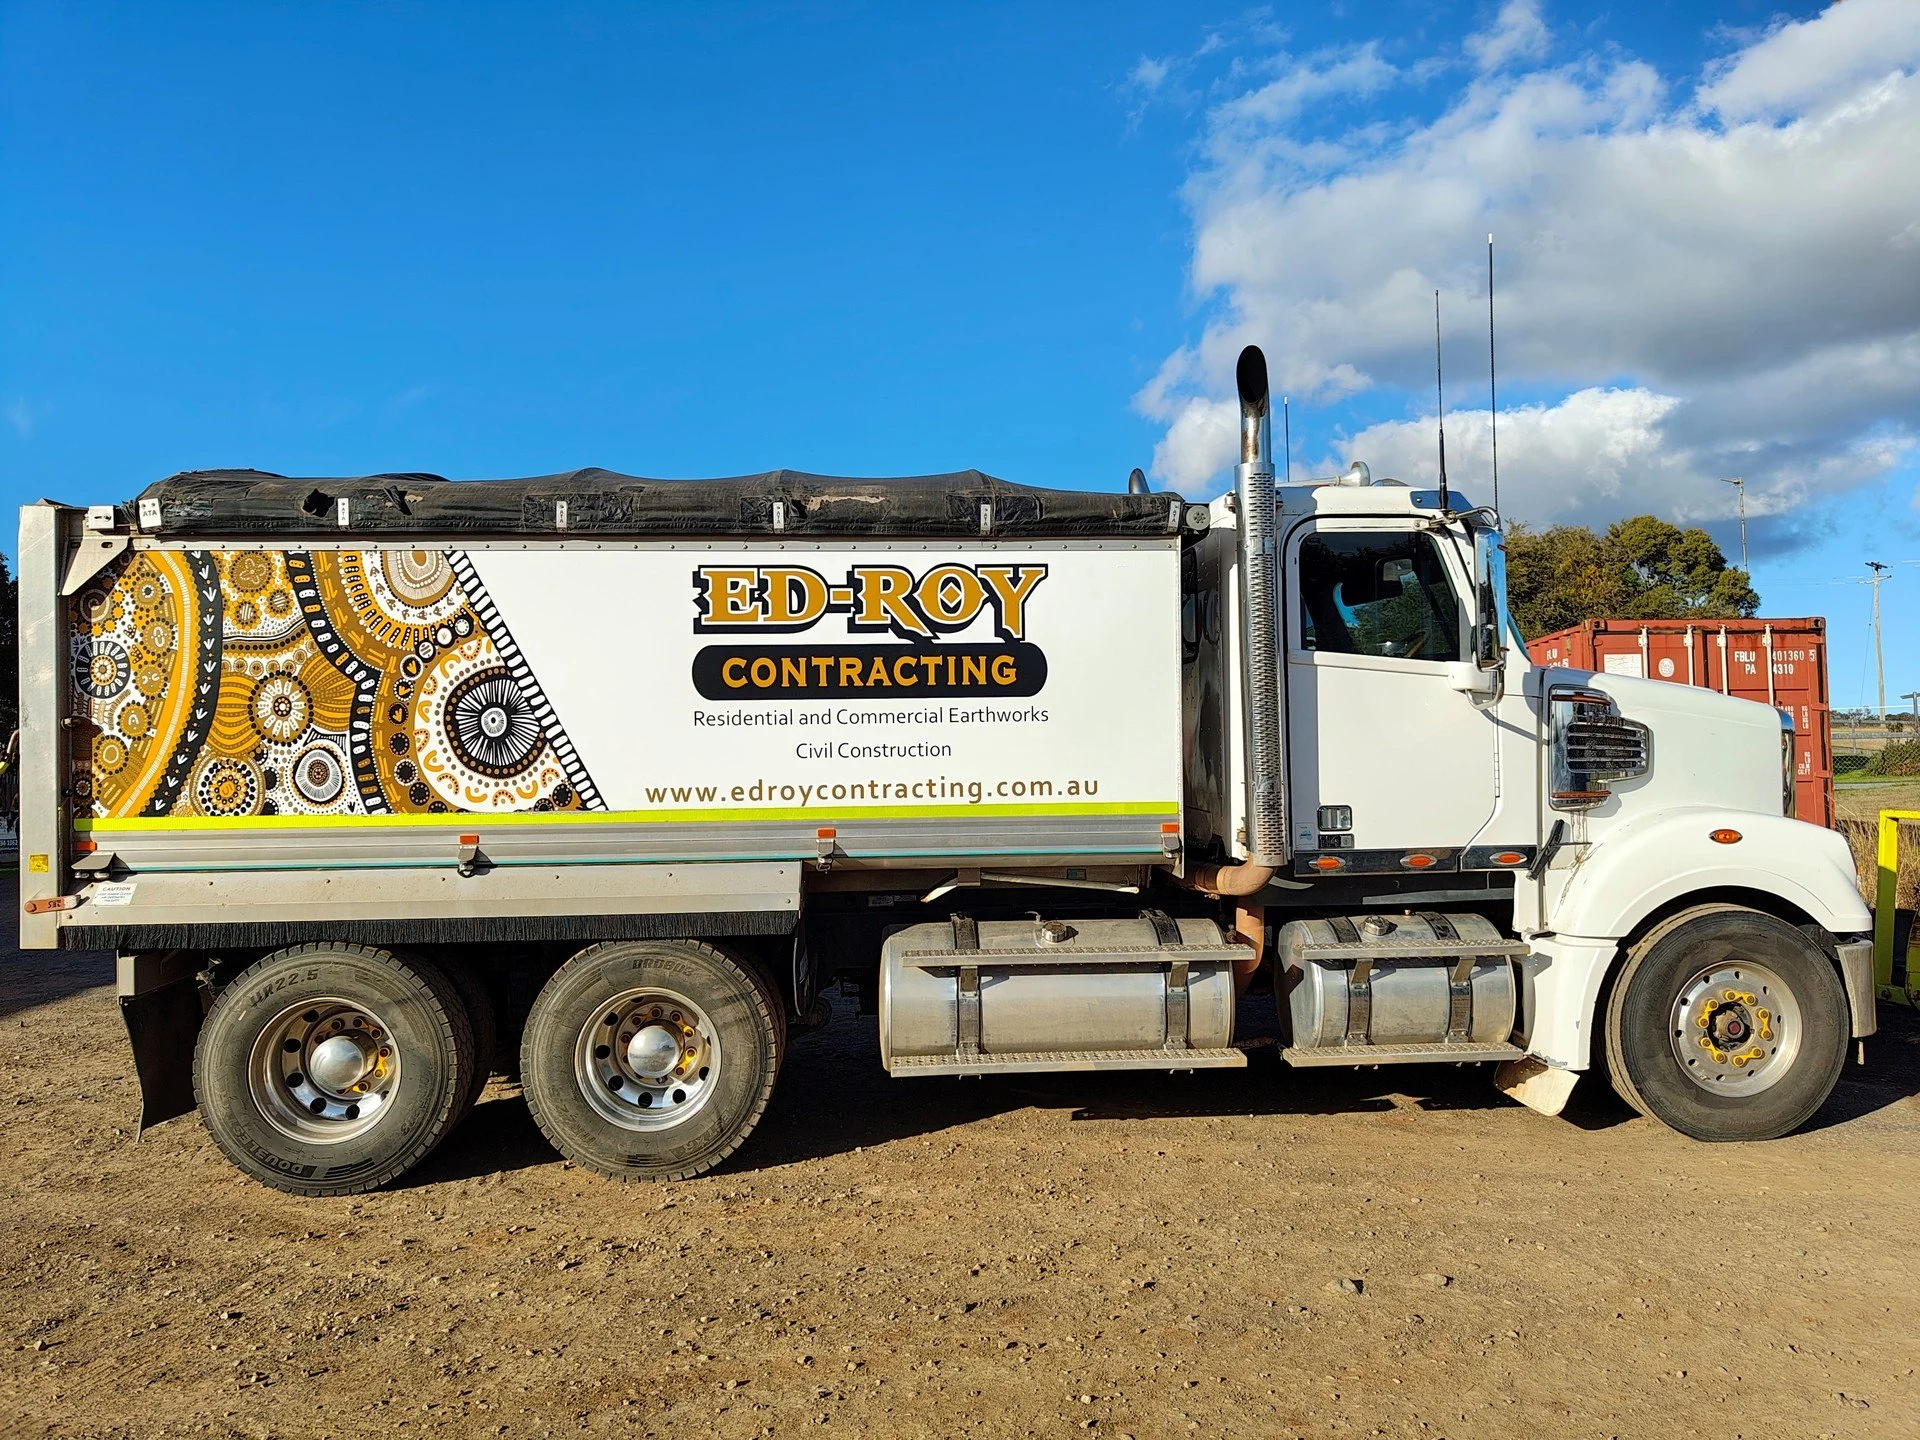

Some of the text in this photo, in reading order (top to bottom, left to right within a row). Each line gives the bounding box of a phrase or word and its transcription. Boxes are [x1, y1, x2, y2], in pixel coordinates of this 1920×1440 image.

[695, 564, 1048, 641] ED-ROY
[1734, 650, 1756, 662] FBLU
[721, 654, 1017, 688] CONTRACTING
[1745, 664, 1794, 675] PA 4310
[693, 706, 1049, 726] Residential and Commercial Earthworks
[796, 742, 951, 758] Civil Construction
[645, 776, 1100, 806] www.edroycontracting.com.au
